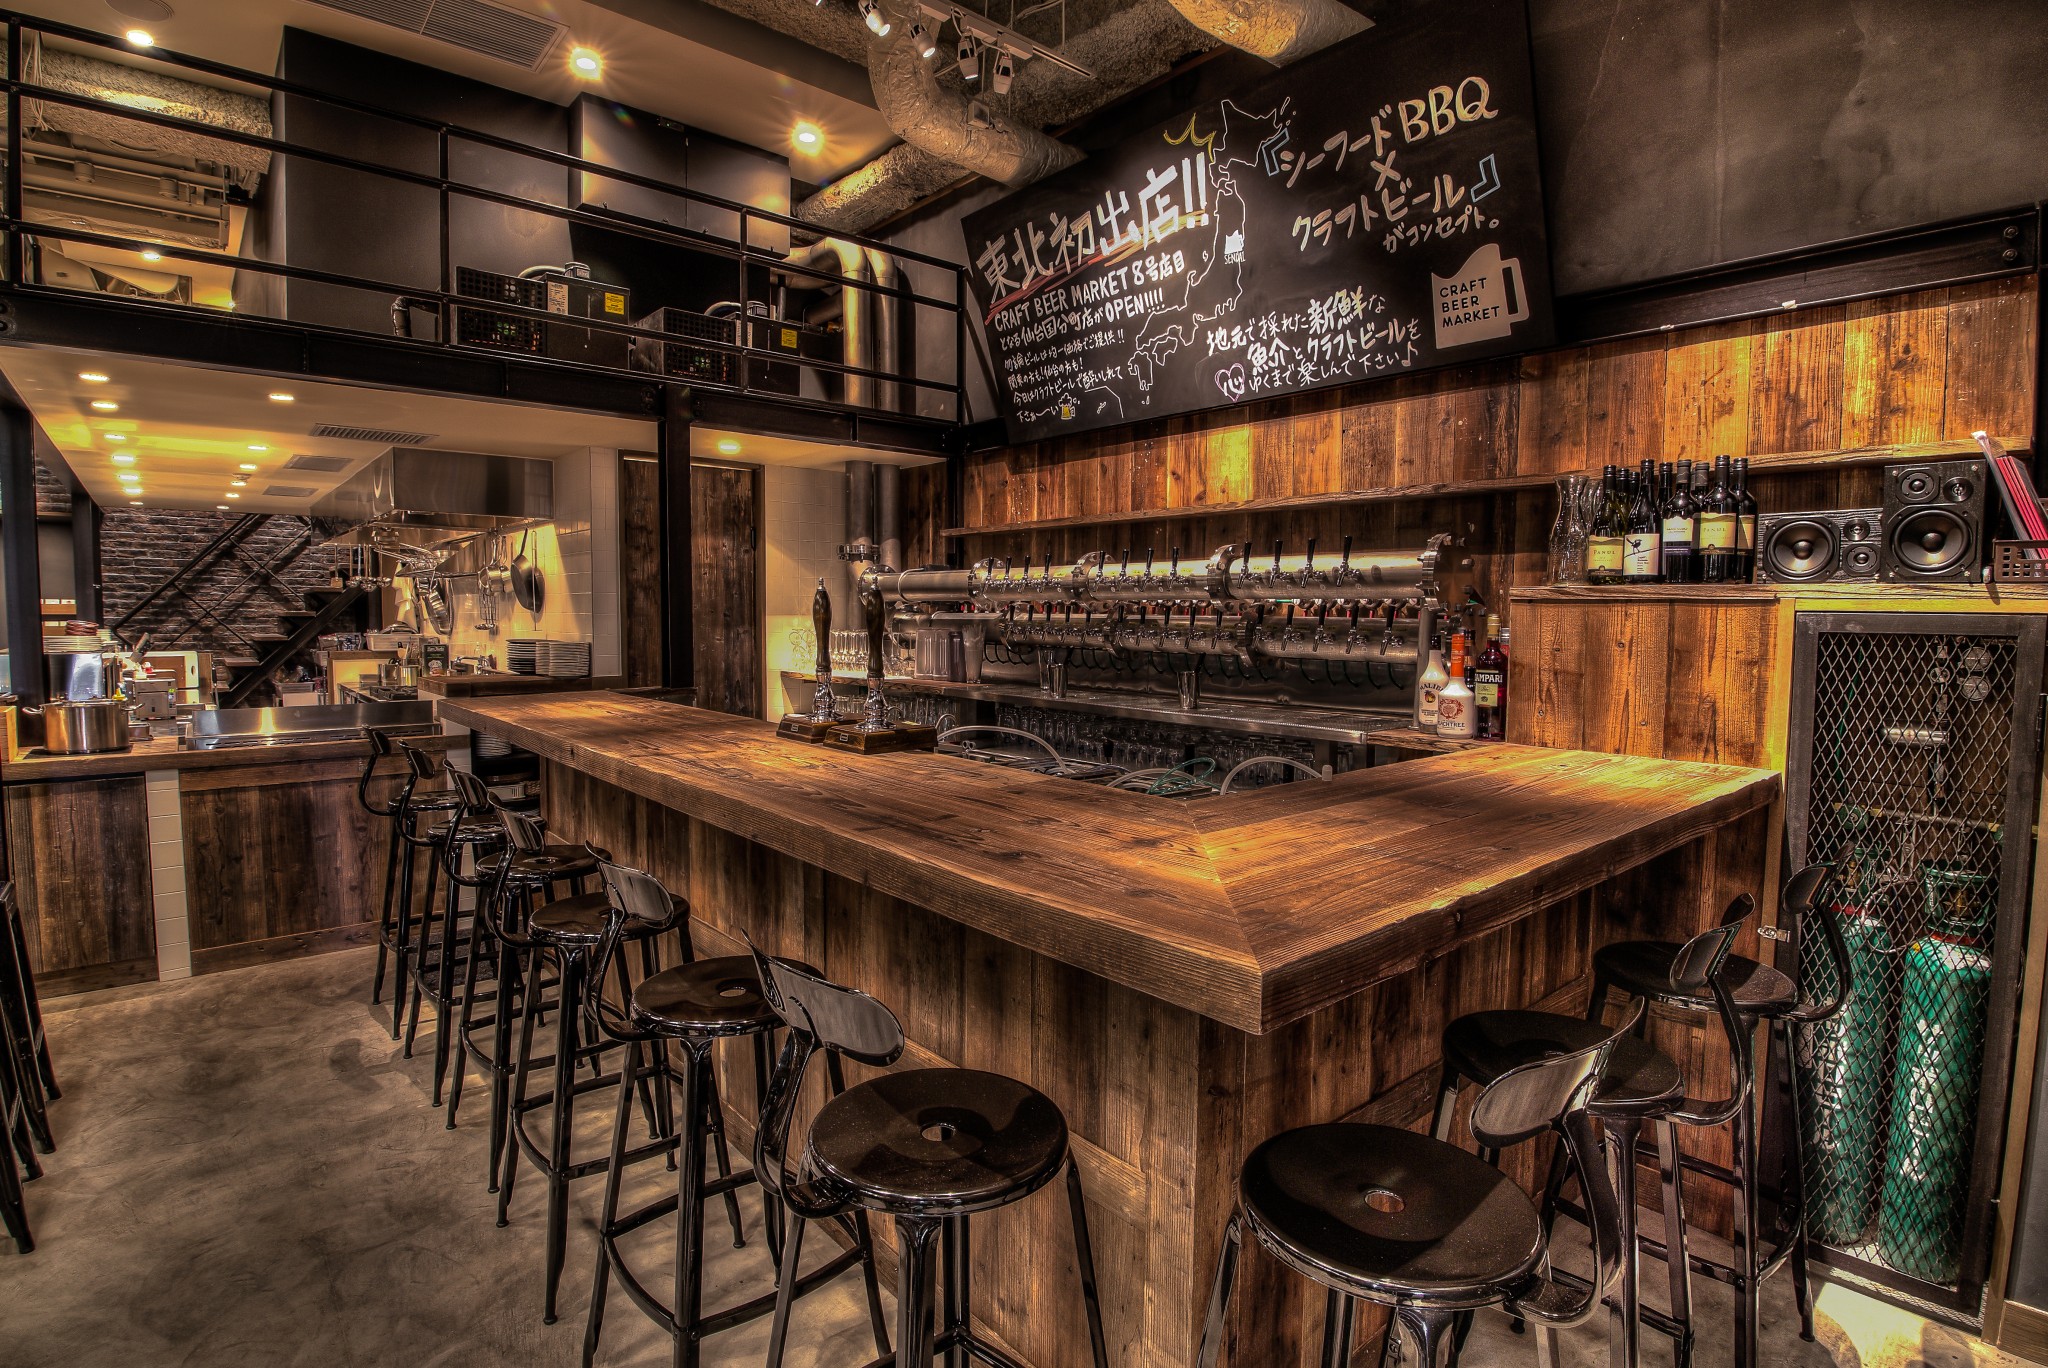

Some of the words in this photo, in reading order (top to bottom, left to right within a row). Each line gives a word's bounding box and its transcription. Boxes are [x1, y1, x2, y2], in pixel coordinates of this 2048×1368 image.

[994, 302, 1030, 332] CRAFT
[1036, 288, 1070, 318] BEER
[1071, 266, 1129, 308] MARKET
[1132, 250, 1185, 286] 8号店目
[1440, 277, 1487, 298] CRAFT
[1441, 295, 1480, 313] BEER
[1206, 286, 1386, 357] 地元で採れた新鮮な
[1442, 306, 1500, 328] MARKET
[1247, 318, 1422, 376] 魚介とクラフトビールを
[1419, 682, 1444, 693] MALIB
[1474, 673, 1503, 683] AMPARI
